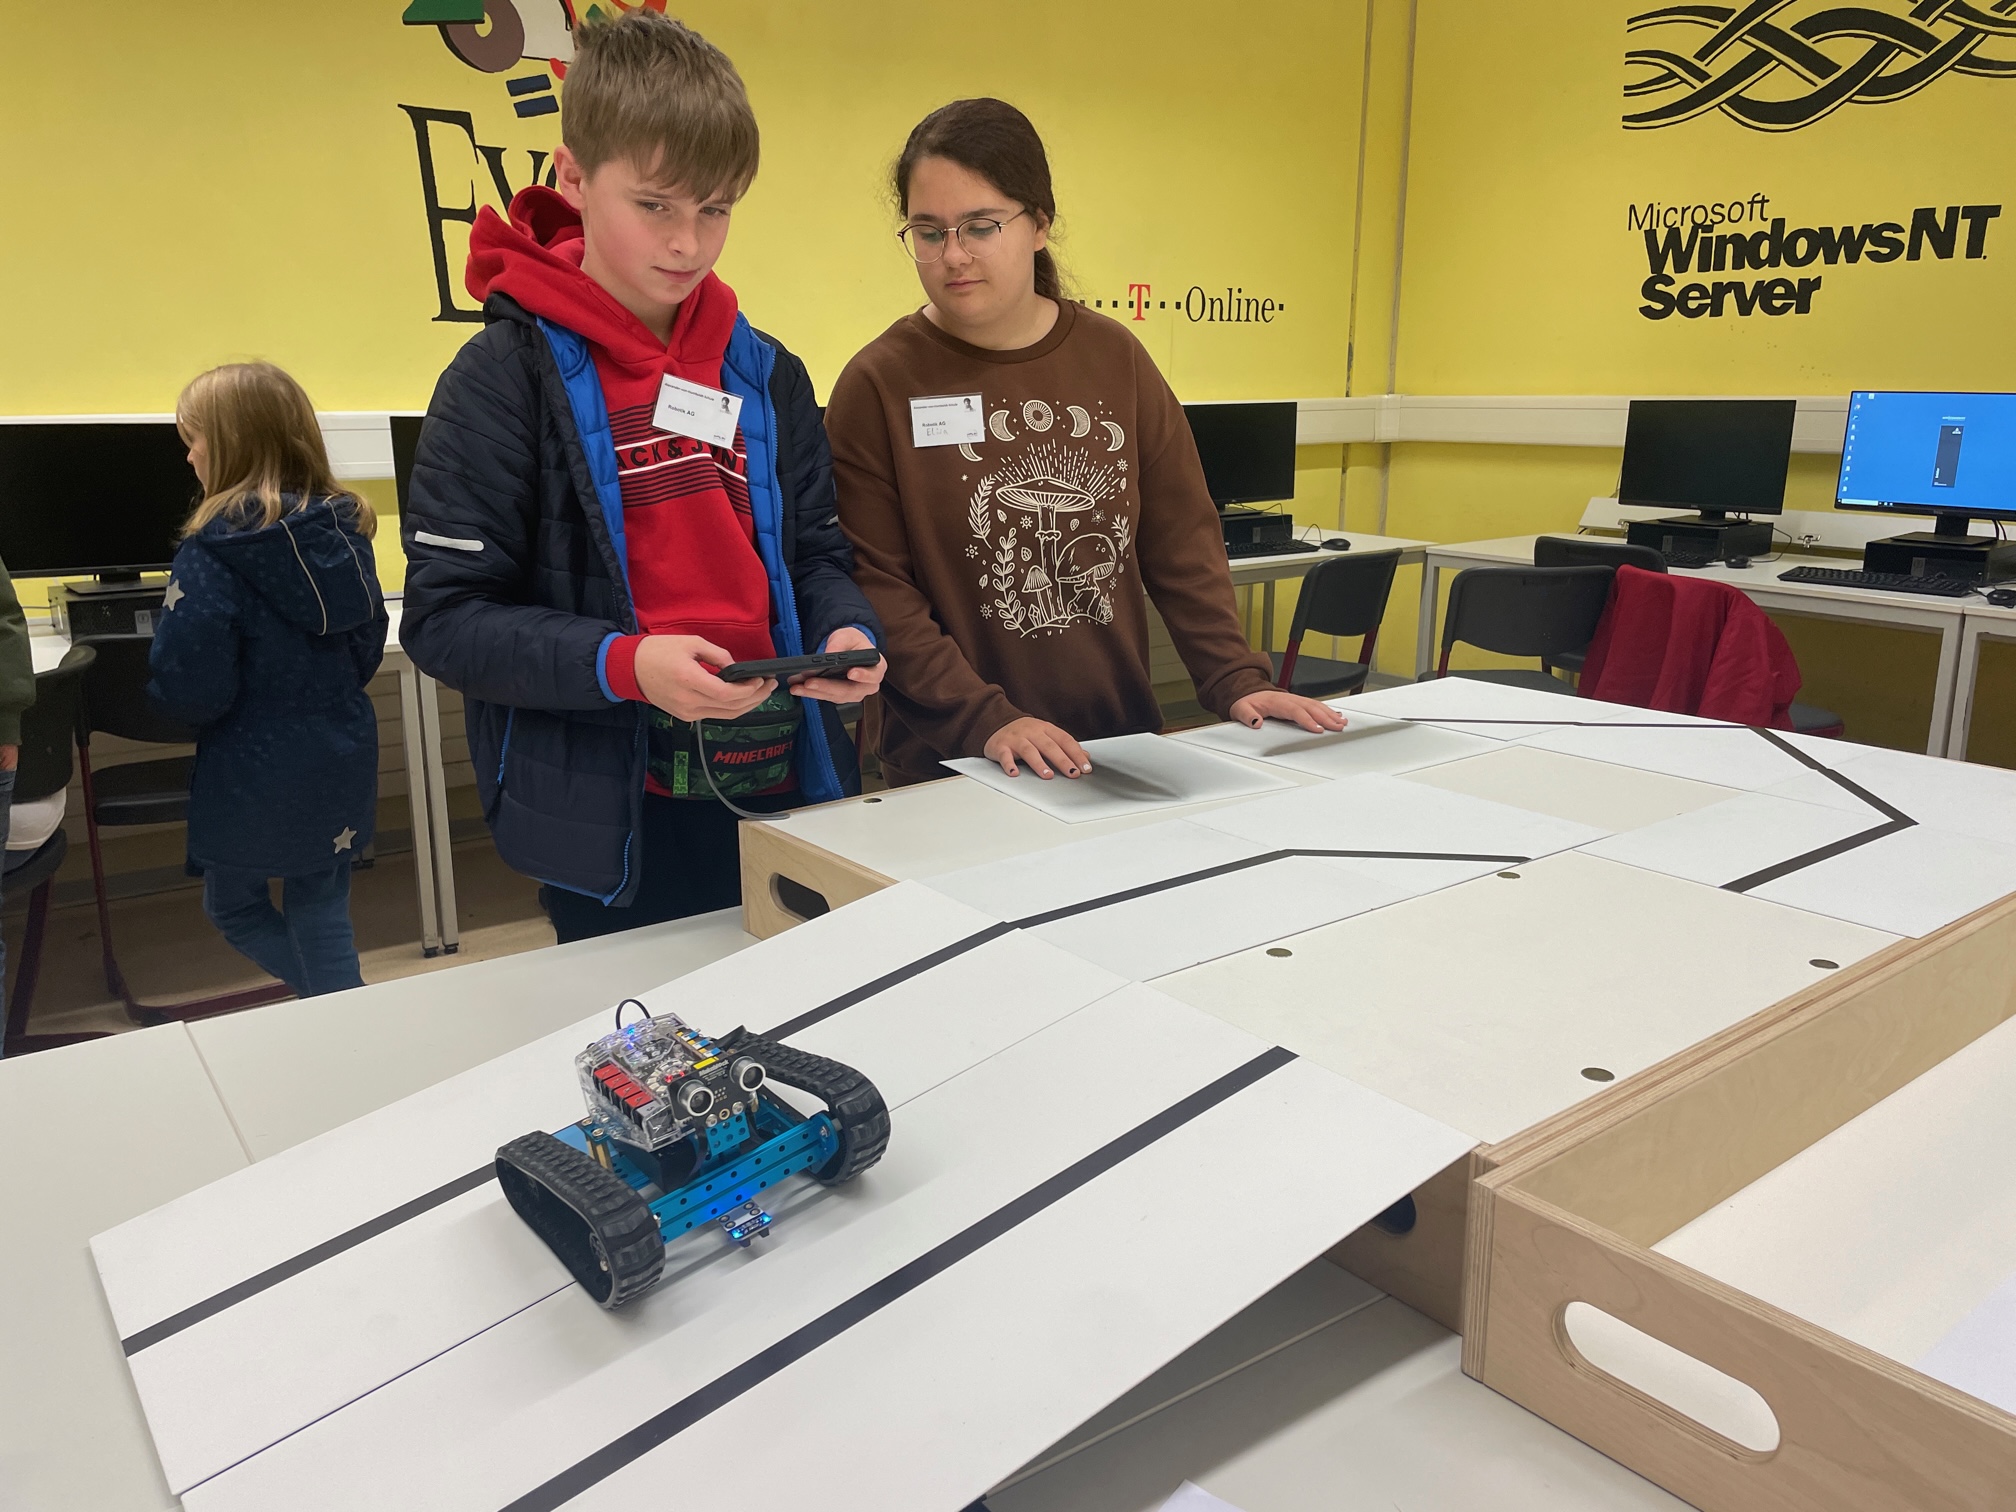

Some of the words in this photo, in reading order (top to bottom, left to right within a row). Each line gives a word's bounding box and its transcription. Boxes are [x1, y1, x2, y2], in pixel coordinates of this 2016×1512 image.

[398, 104, 558, 323] Ev
[1627, 192, 1770, 231] Microsoft
[1638, 274, 1822, 320] Server
[713, 742, 792, 764] MINECRAFT
